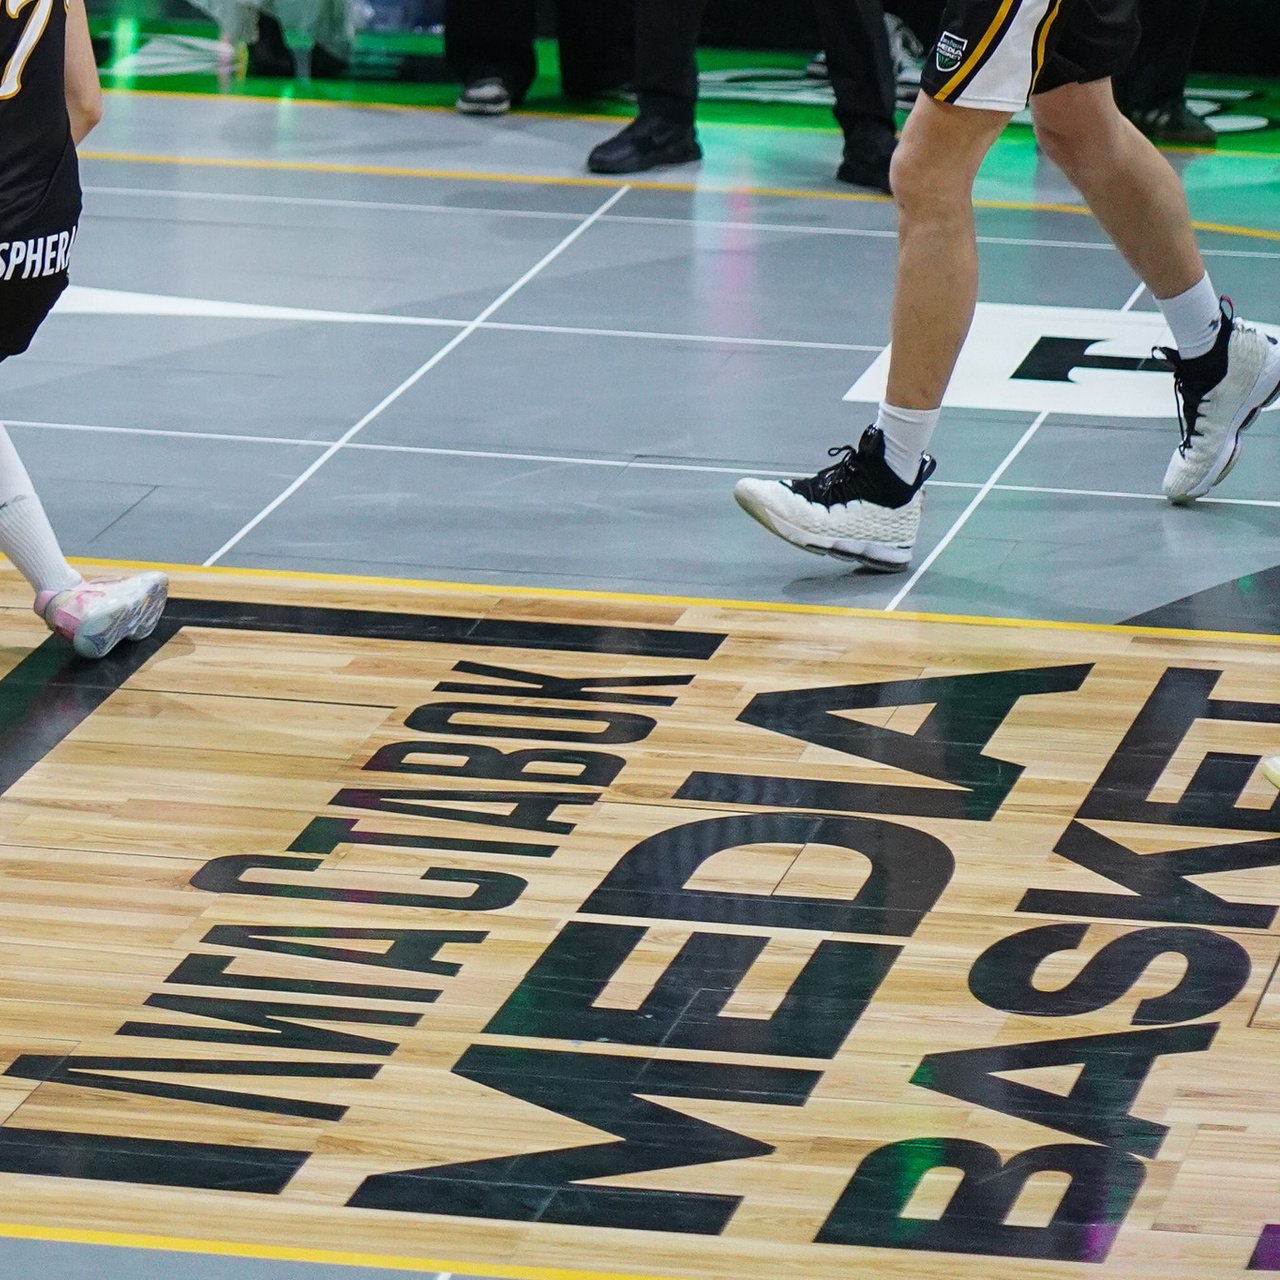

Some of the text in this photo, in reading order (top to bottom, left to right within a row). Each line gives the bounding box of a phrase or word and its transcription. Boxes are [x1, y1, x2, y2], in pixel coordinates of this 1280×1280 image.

[4, 661, 694, 1122] ЛИГА СТАВОК
[346, 662, 1093, 1236] MEDIA
[814, 666, 1280, 1264] BASKET
